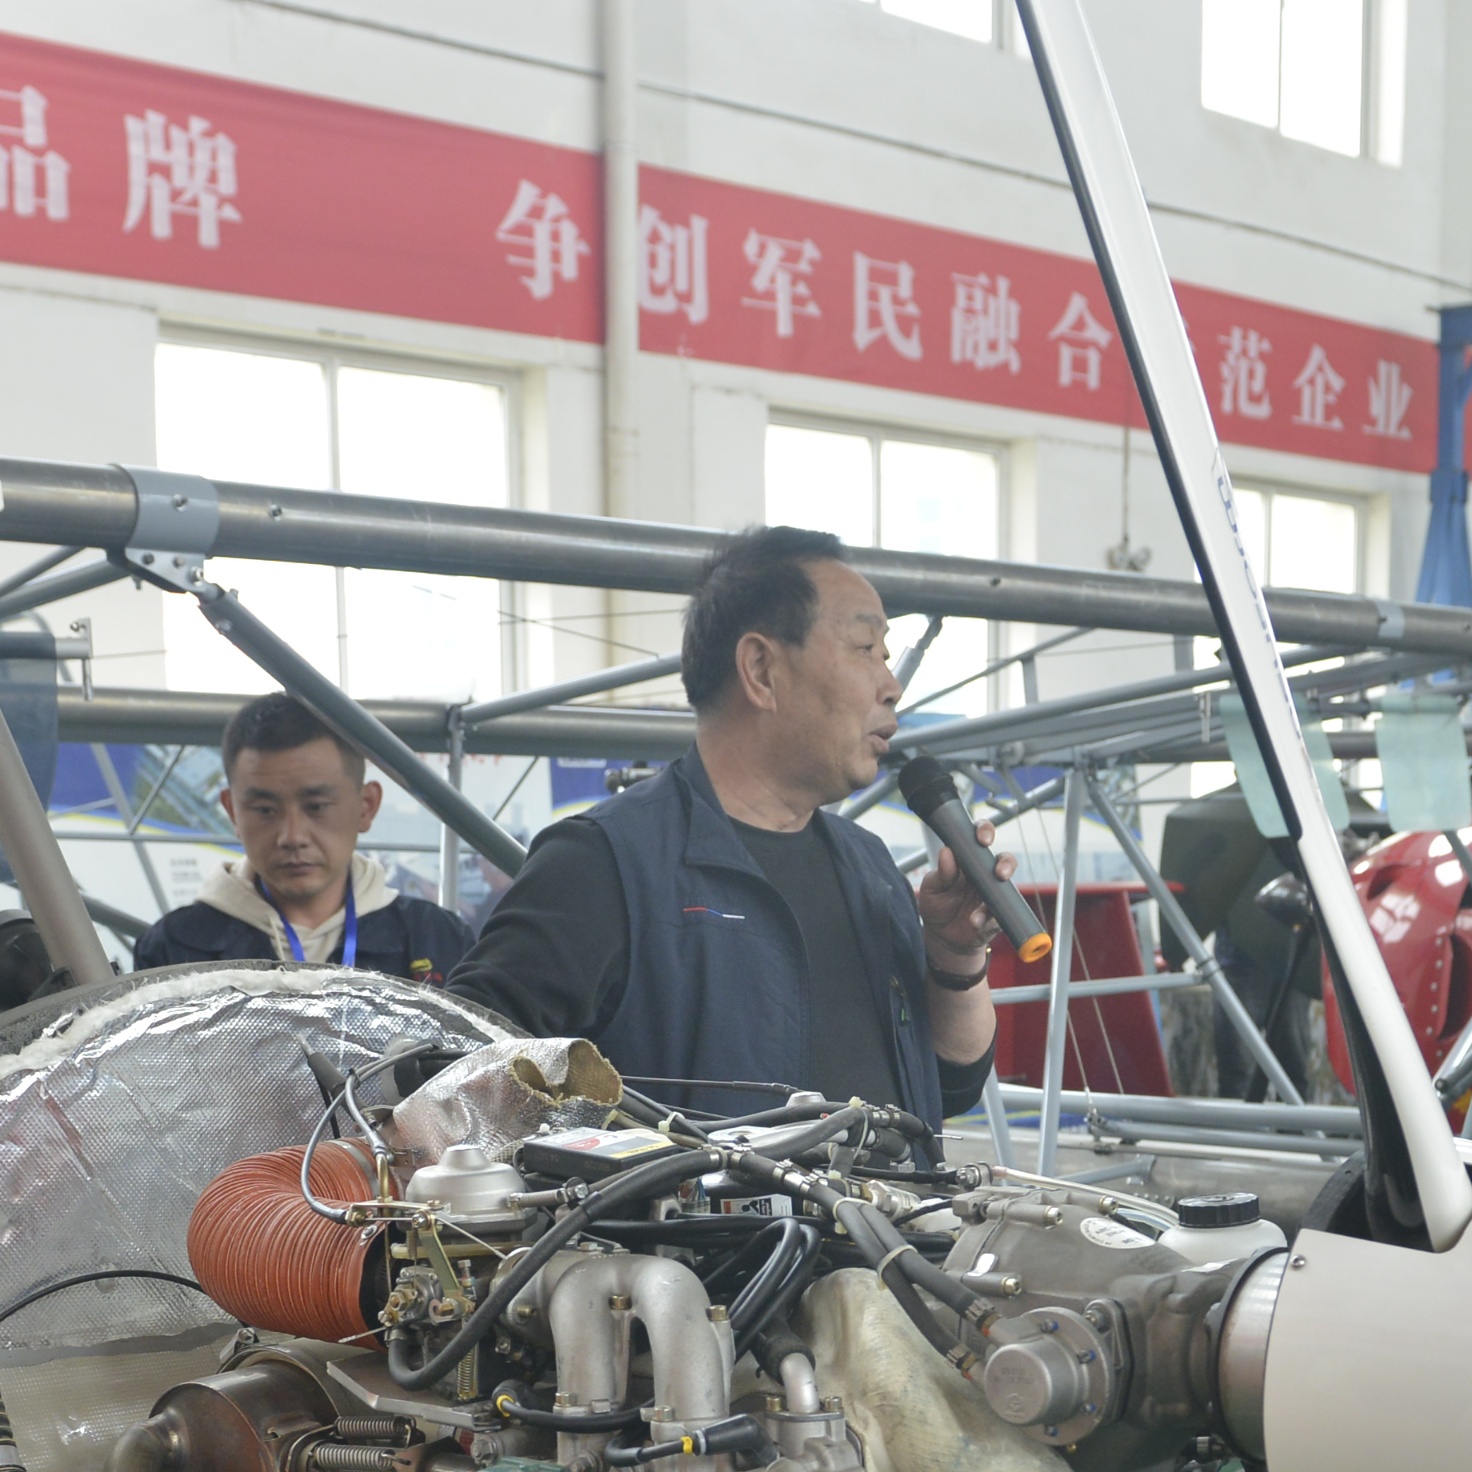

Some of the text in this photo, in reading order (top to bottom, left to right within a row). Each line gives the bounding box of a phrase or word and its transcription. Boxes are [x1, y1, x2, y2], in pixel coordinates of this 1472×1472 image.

[496, 178, 1414, 441] 争创军民融合范企业
